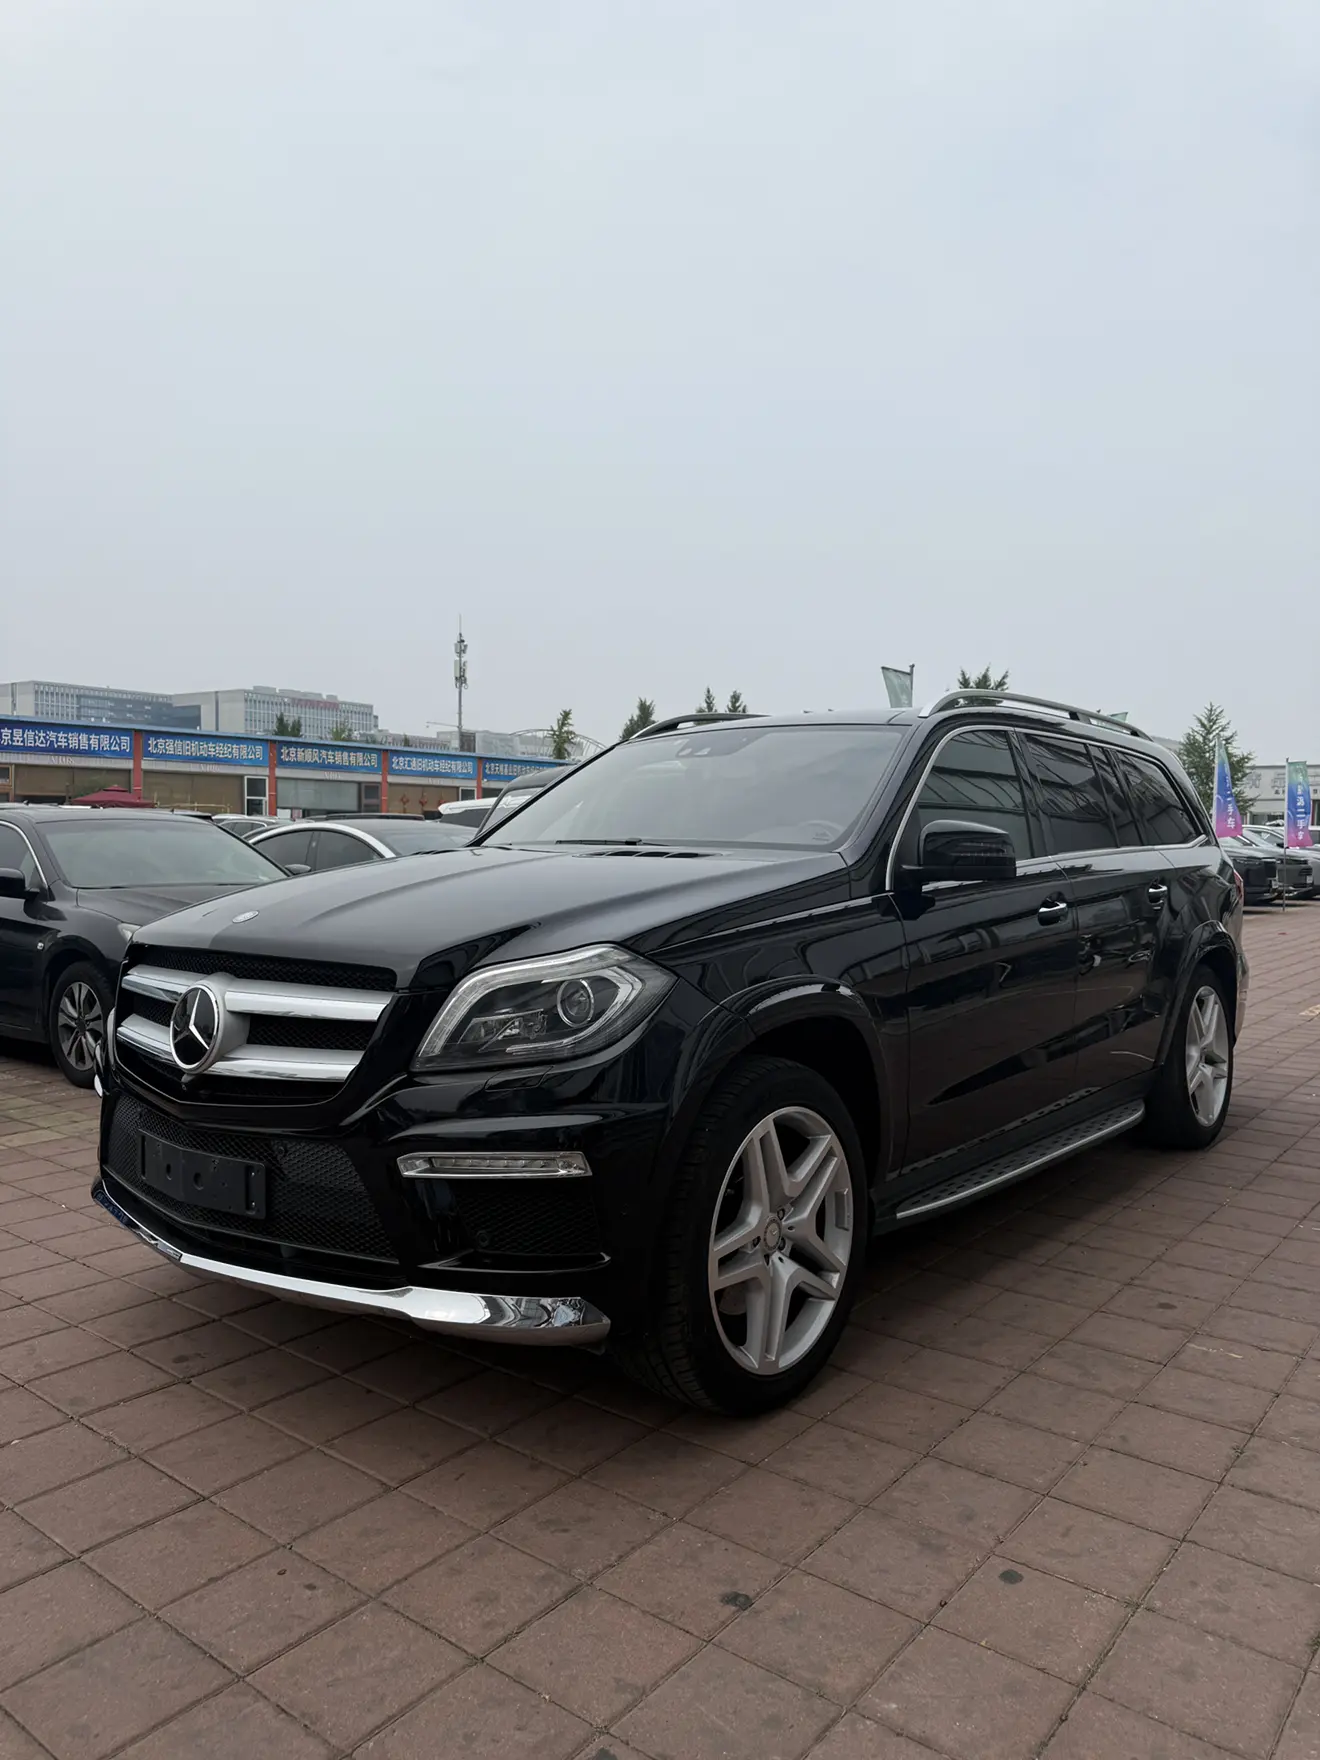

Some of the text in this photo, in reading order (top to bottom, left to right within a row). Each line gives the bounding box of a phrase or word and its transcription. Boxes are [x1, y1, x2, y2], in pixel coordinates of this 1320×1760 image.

[0, 727, 131, 753] 京昱信达汽车销售有限公司
[148, 736, 263, 761] 北京强信旧机动车经纪有限公司
[280, 745, 378, 768] 北京新顺风汽车销售有限公司
